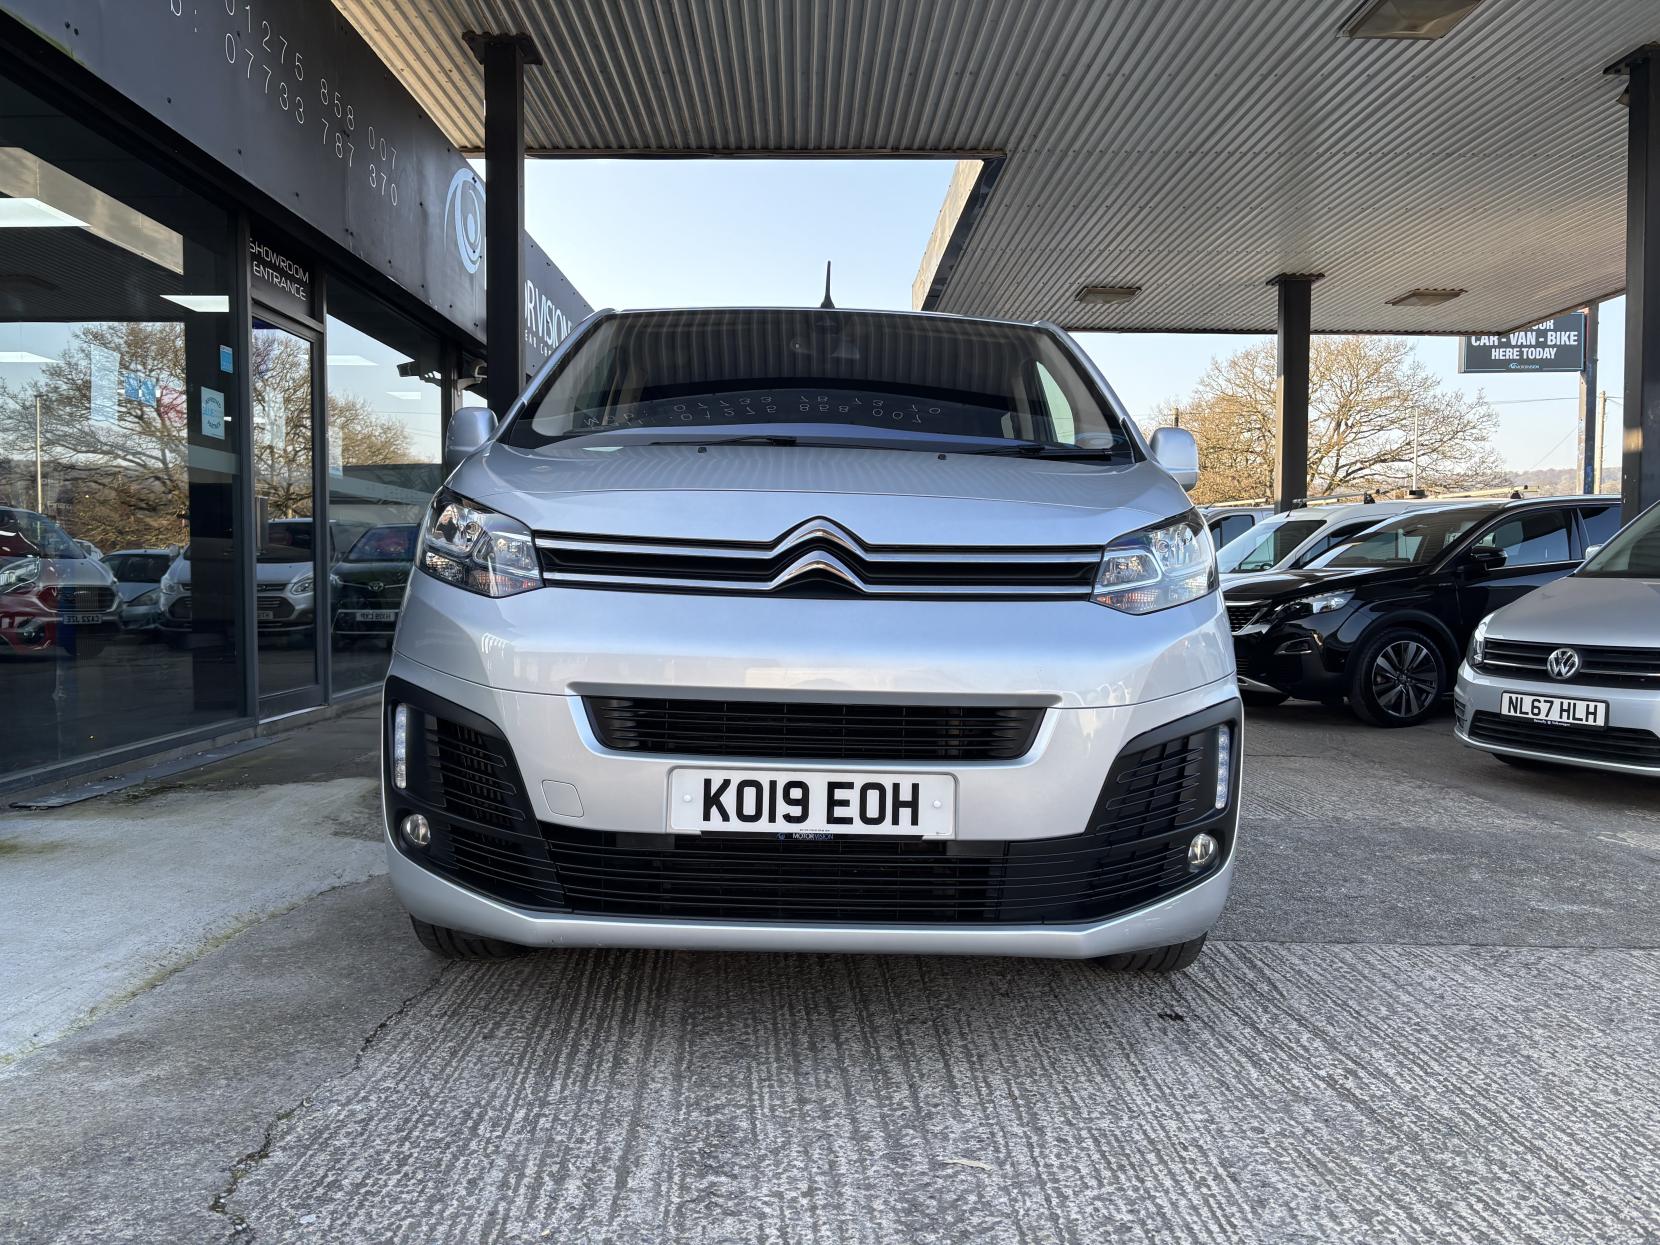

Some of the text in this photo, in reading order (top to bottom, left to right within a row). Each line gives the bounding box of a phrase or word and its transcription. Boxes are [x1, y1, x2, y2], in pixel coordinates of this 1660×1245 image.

[225, 33, 397, 206] 07733 787 370
[320, 79, 354, 130] 858
[368, 127, 397, 169] 007
[249, 237, 309, 284] SHOWROOM
[253, 261, 307, 301] ENTRANCE
[1491, 347, 1557, 360] HERE TODAY
[1509, 331, 1536, 346] VAN
[1547, 331, 1578, 345] BIKE
[1507, 696, 1598, 724] NL67 HLH
[702, 777, 920, 827] KO19 EOH
